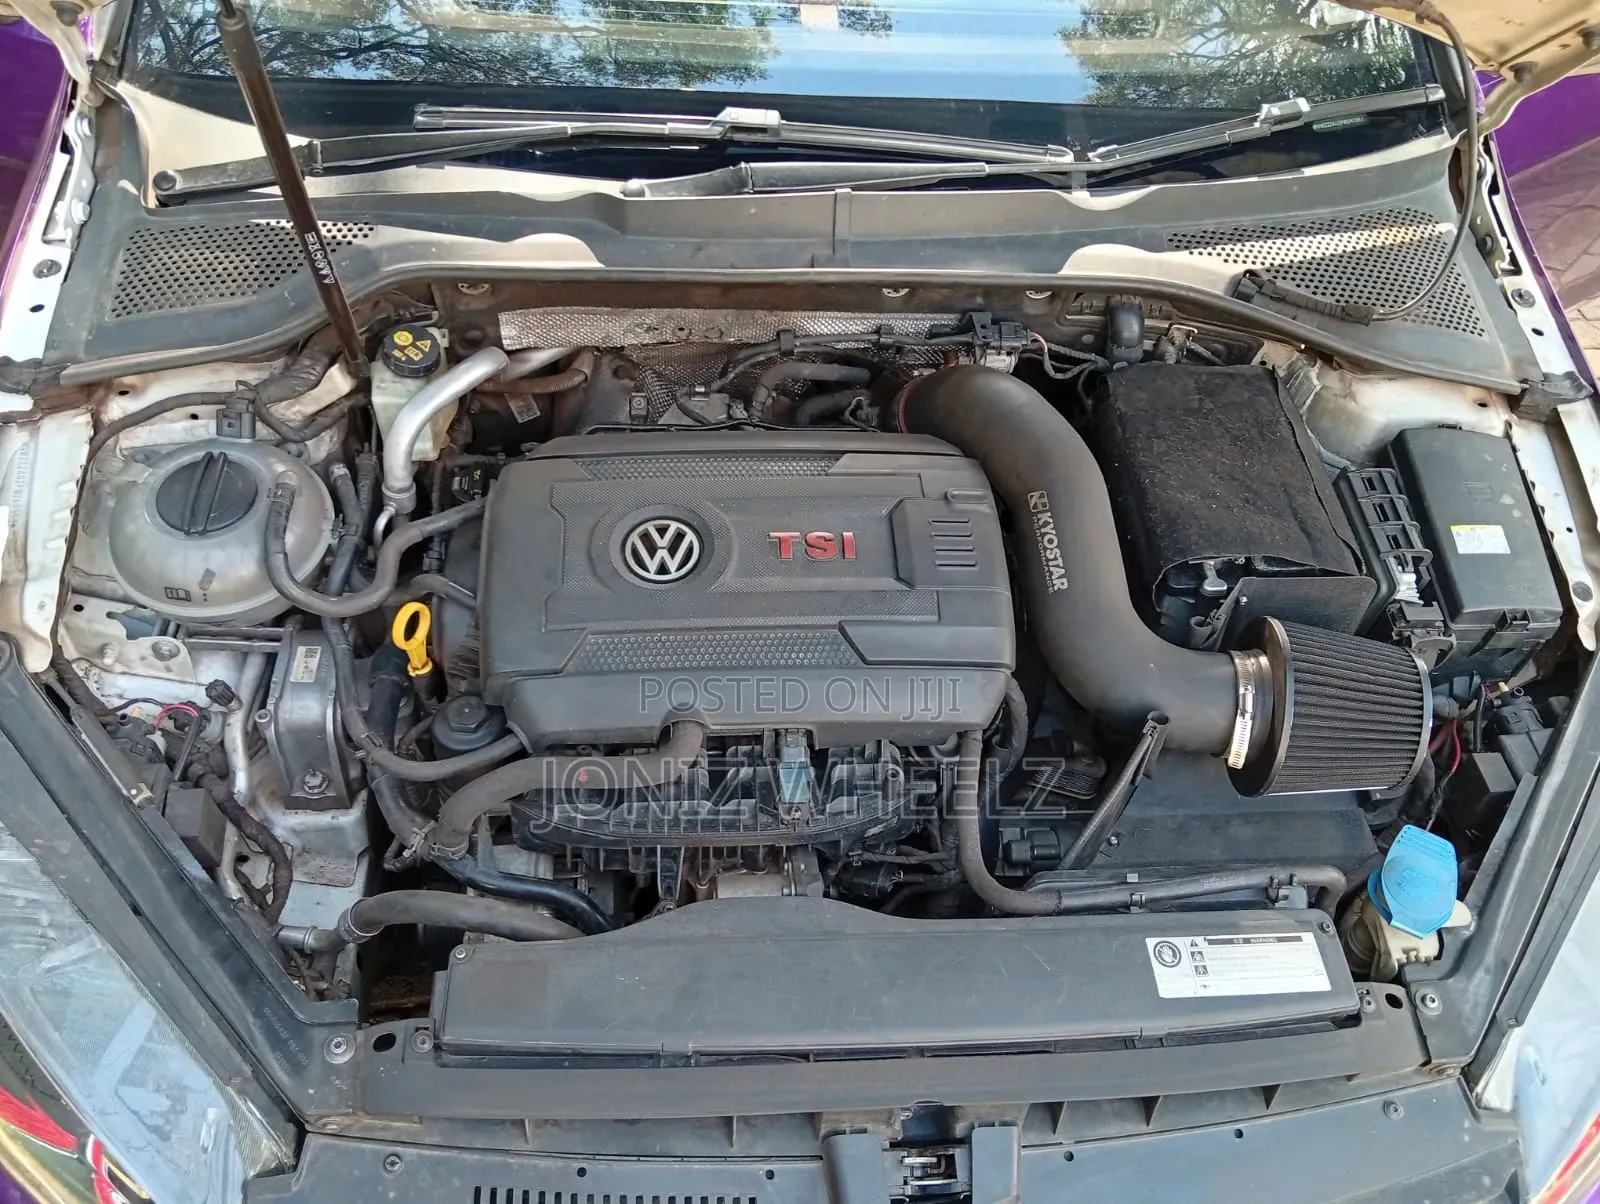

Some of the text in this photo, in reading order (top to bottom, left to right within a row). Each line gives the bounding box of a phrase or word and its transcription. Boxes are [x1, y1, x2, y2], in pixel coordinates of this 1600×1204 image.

[625, 519, 700, 581] VW
[767, 531, 857, 561] TSI
[1032, 515, 1055, 595] PERFORMANCE
[1037, 511, 1068, 591] KYOSTAR
